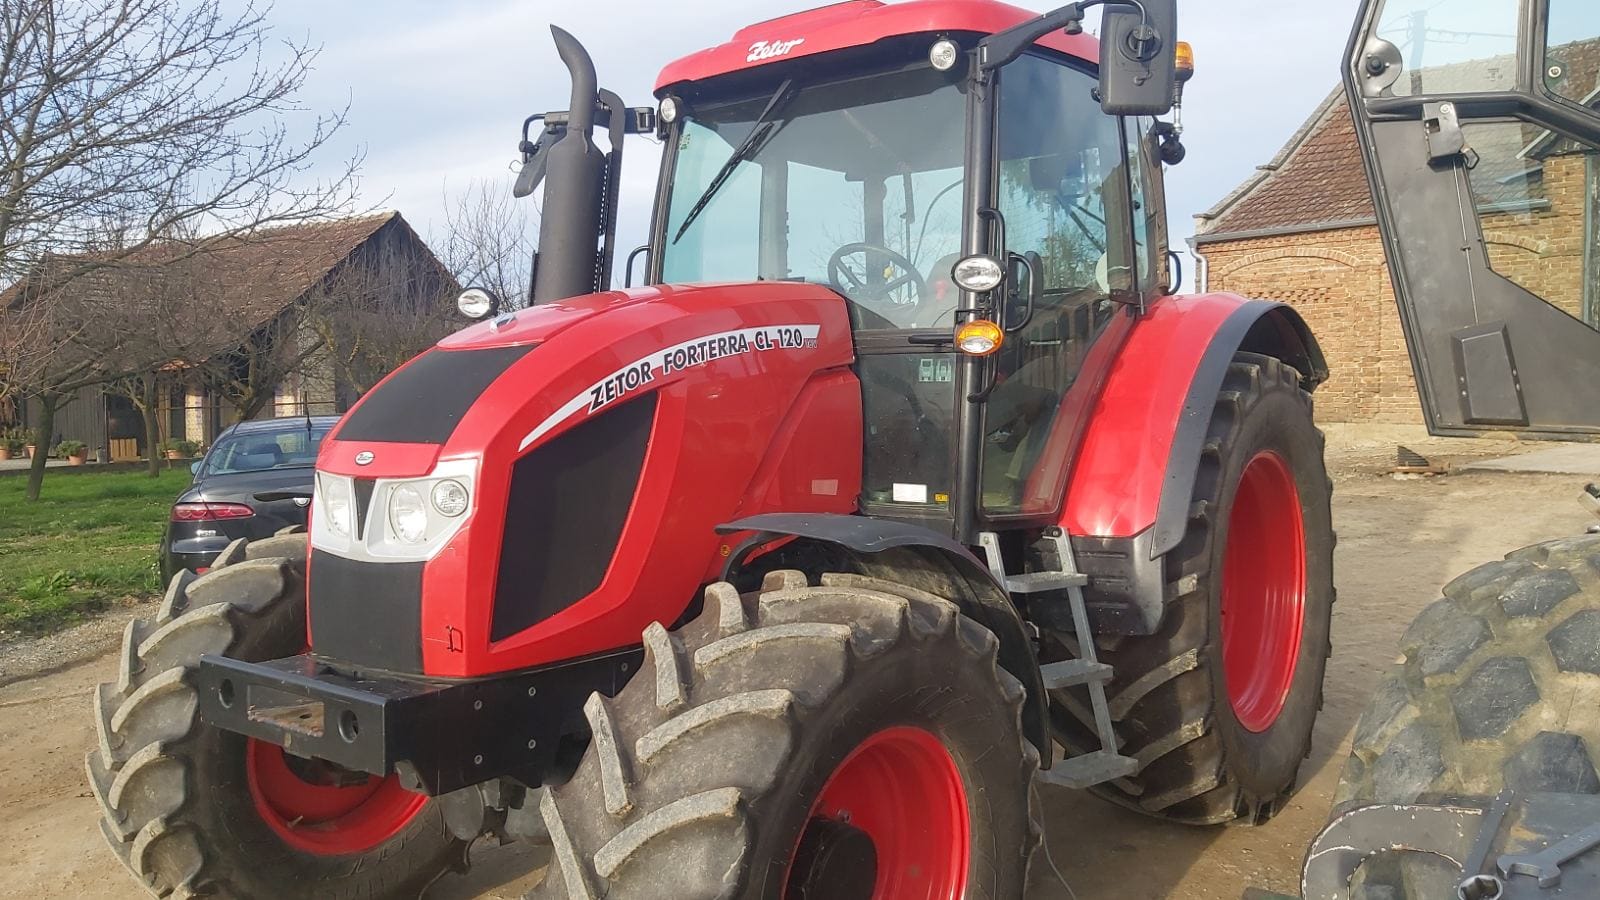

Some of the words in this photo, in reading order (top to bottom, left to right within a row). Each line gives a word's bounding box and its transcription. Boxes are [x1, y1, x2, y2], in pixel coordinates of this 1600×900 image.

[746, 38, 805, 62] Zetor
[589, 361, 653, 412] ZETOR
[663, 333, 749, 374] FORTERRA
[754, 330, 773, 350] CL
[777, 328, 803, 348] 120
